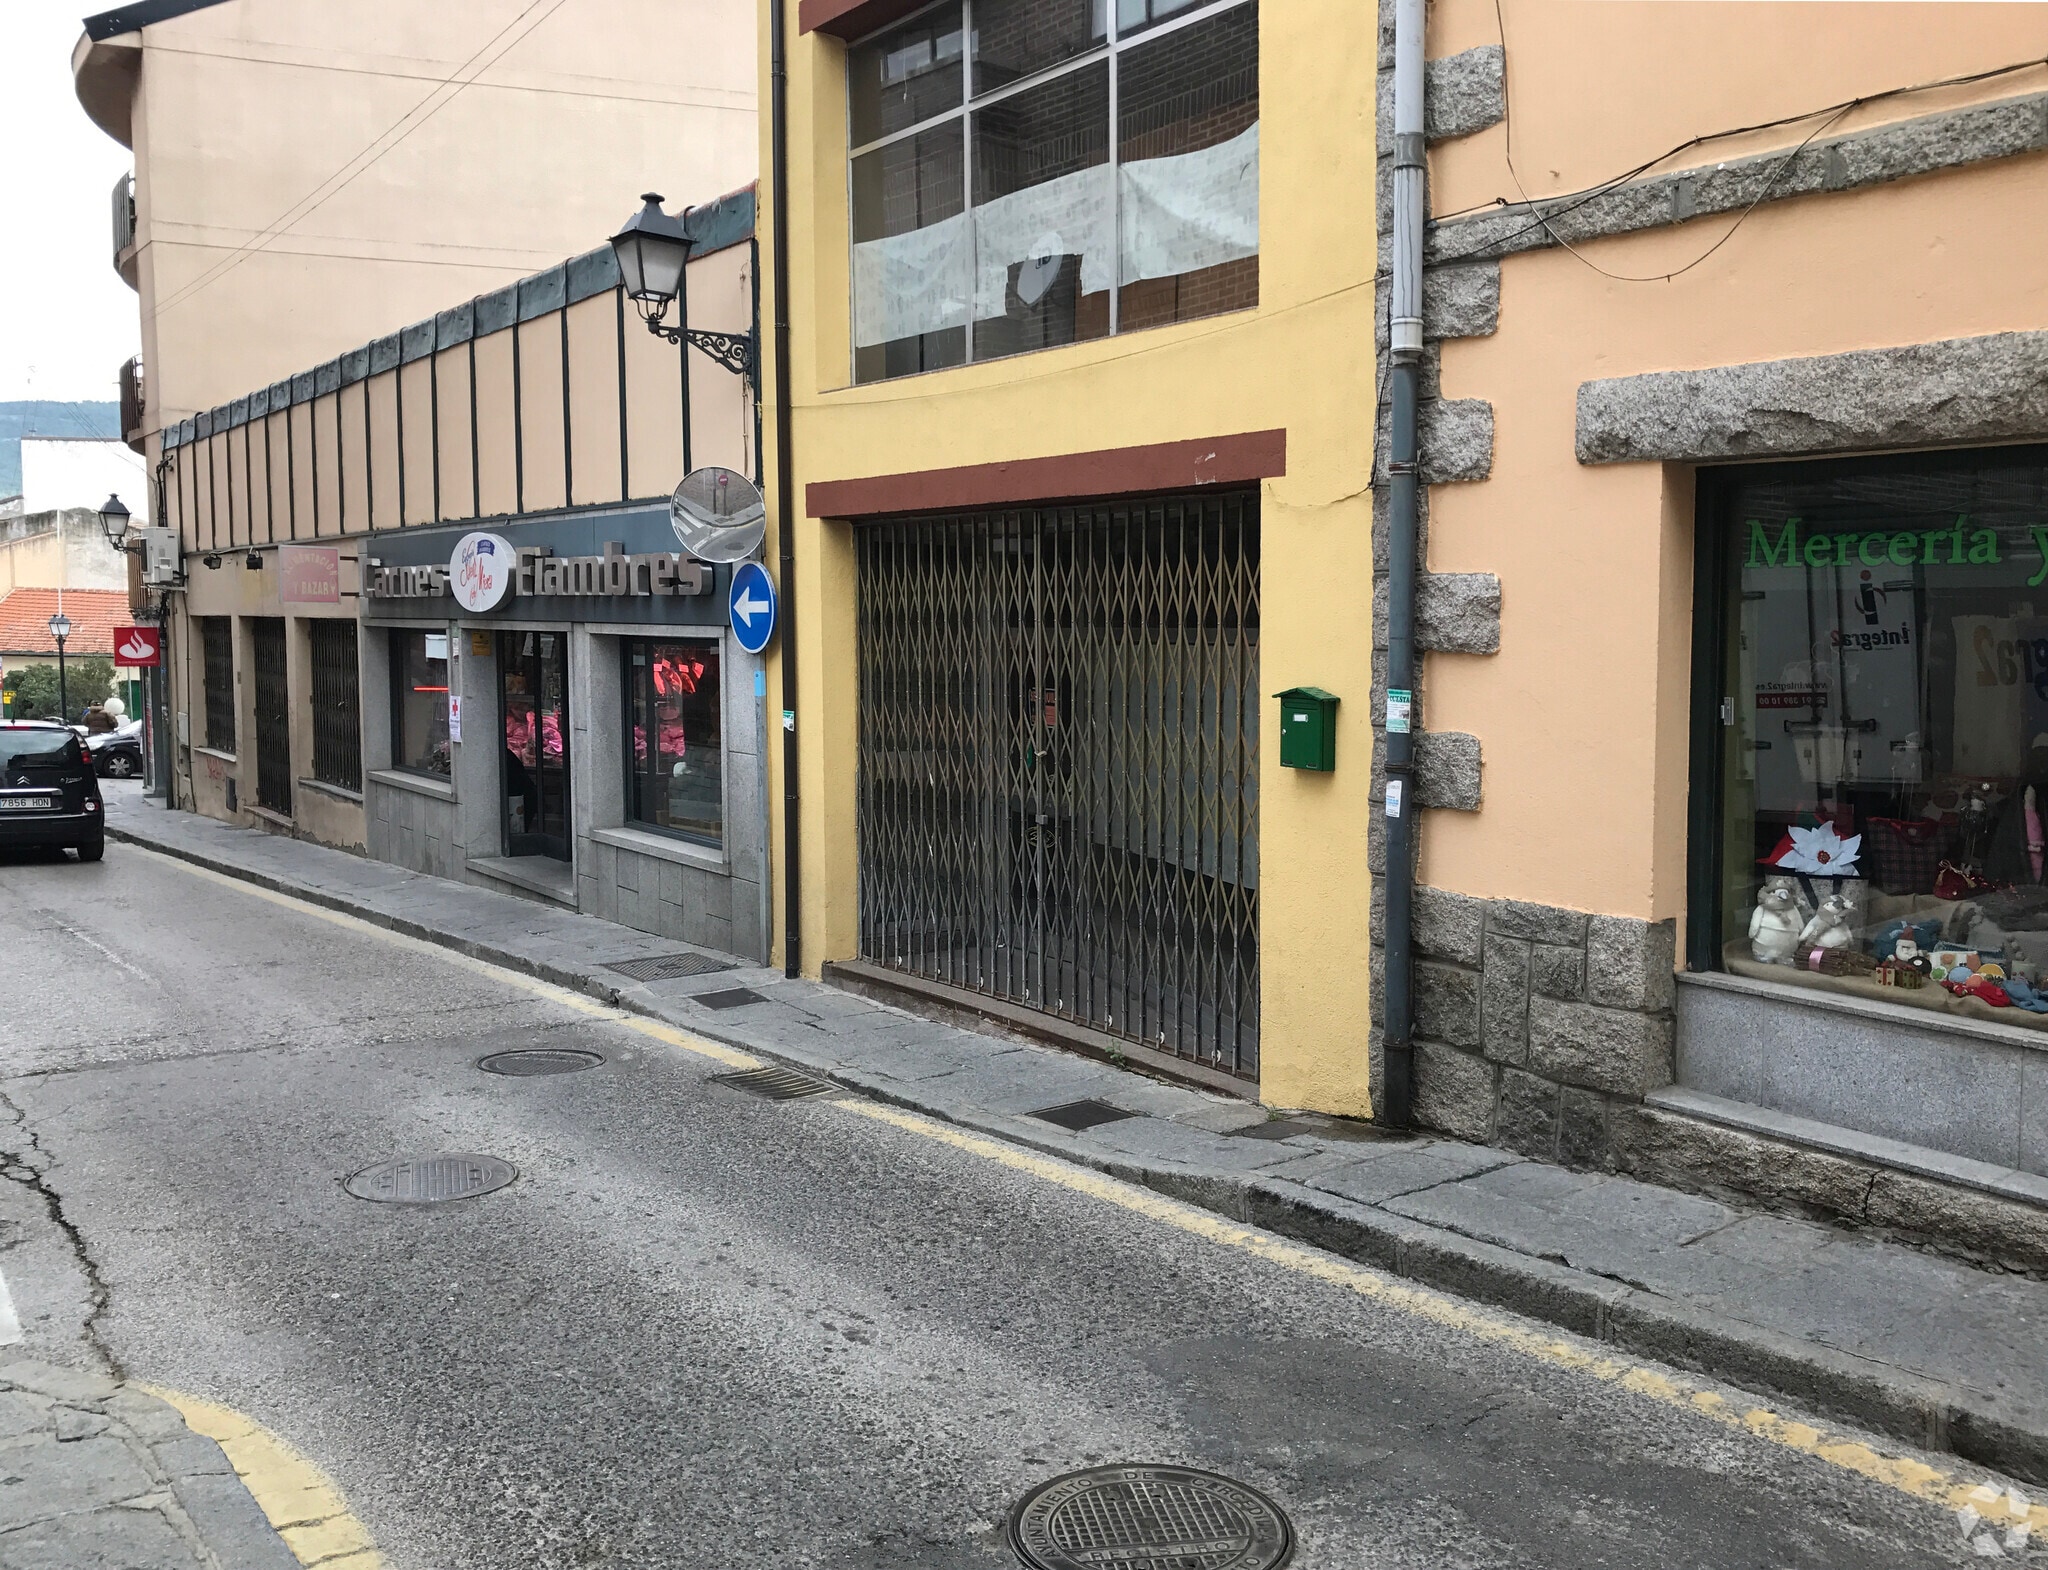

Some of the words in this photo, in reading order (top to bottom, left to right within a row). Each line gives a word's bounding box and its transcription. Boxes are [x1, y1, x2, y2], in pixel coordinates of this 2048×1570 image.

[1744, 514, 2002, 568] Mercería
[302, 581, 329, 595] BAZAR
[362, 557, 447, 598] Carnes
[516, 541, 706, 596] Fiambres
[1, 799, 27, 807] 7856
[32, 798, 50, 807] HDN
[1028, 1479, 1093, 1558] AYUNTAMIENTO
[1125, 1471, 1153, 1480] DE
[1090, 1541, 1231, 1560] REGISTRO
